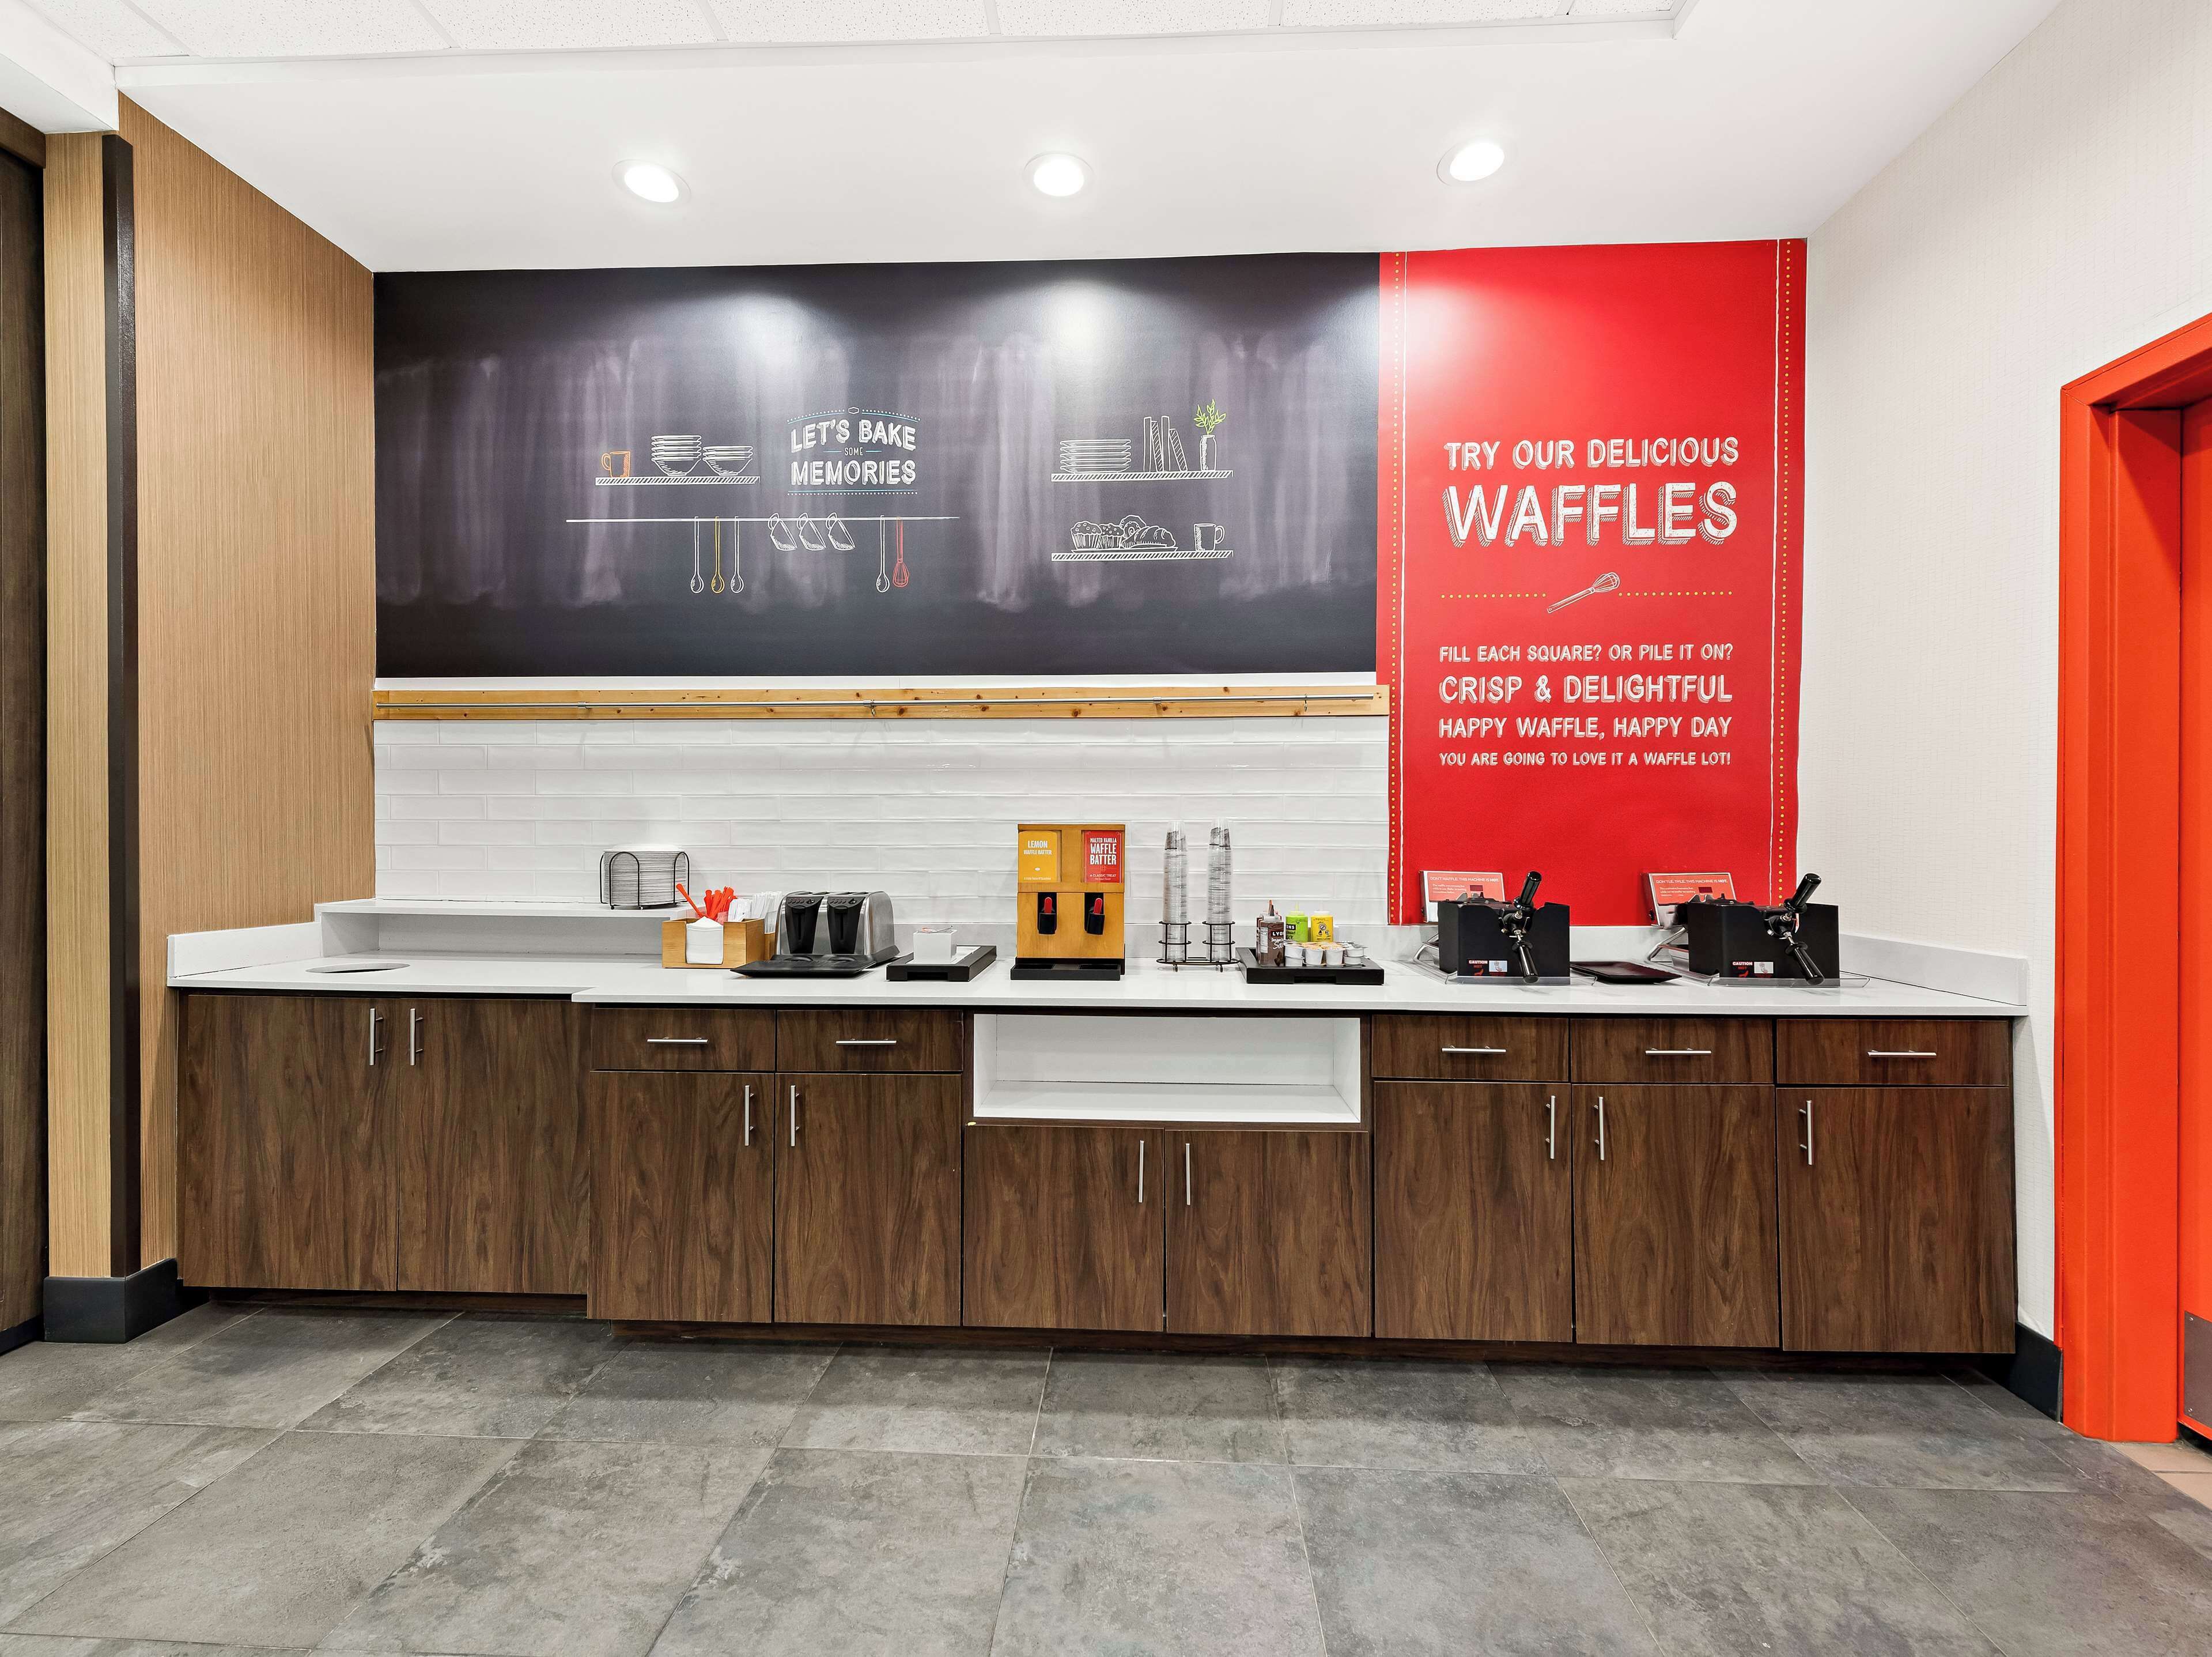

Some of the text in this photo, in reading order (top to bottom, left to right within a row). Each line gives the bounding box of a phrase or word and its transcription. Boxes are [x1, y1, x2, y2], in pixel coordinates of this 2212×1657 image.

[791, 419, 916, 453] LET'S BAKE
[844, 447, 863, 456] SOME
[1443, 437, 1739, 470] TRY OUR DELICIOUS
[791, 460, 916, 485] MEMORIES
[1442, 481, 1738, 548] WAFFLES
[1439, 643, 1733, 662] FILL EACH SQUARE? OR PILE IT ON?
[1439, 674, 1733, 703] CRISP & DELIGHTFUL
[1439, 716, 1732, 740] HAPPY WAFFLE, HAPPY DAY
[1439, 752, 1731, 765] YOU ARE GOING TO LOVE IT A WAFFLE LOT!
[1027, 840, 1048, 848] LEMON
[1090, 843, 1117, 854] WAFFLE
[1090, 854, 1117, 865] BATTER
